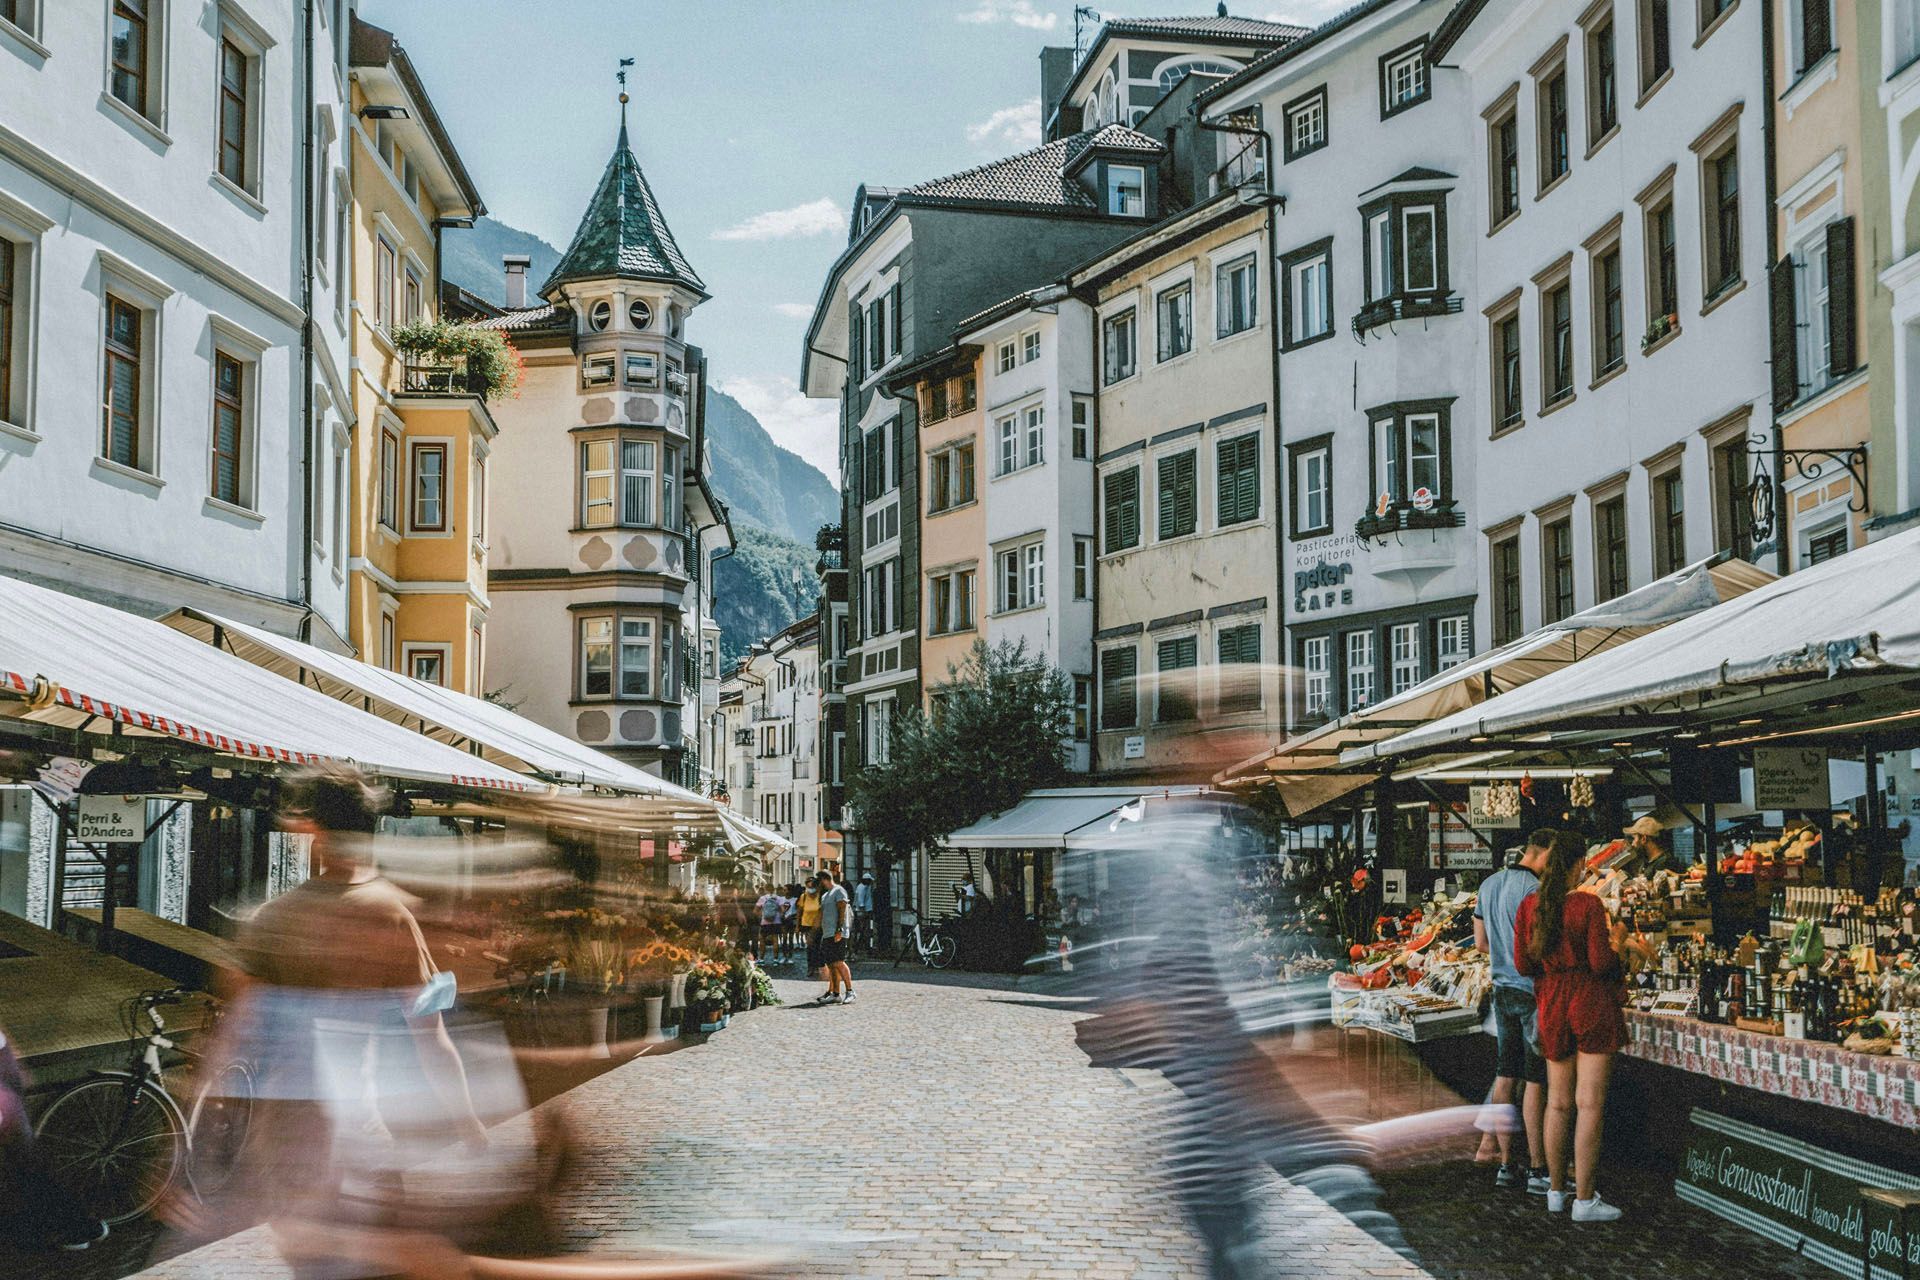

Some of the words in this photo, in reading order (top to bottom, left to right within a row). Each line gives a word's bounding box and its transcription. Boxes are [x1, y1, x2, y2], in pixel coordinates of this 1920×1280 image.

[1296, 534, 1355, 554] Pasticceria
[1296, 545, 1355, 566] Konditorei
[1294, 561, 1353, 597] peter
[1294, 589, 1353, 613] CAFE
[82, 813, 109, 824] Perri
[111, 813, 122, 824] &
[1473, 816, 1503, 825] Italiani
[81, 826, 134, 837] D'Andrea
[1718, 1146, 1811, 1219] Genussstandl
[1811, 1192, 1840, 1232] banco
[1840, 1205, 1866, 1242] dell
